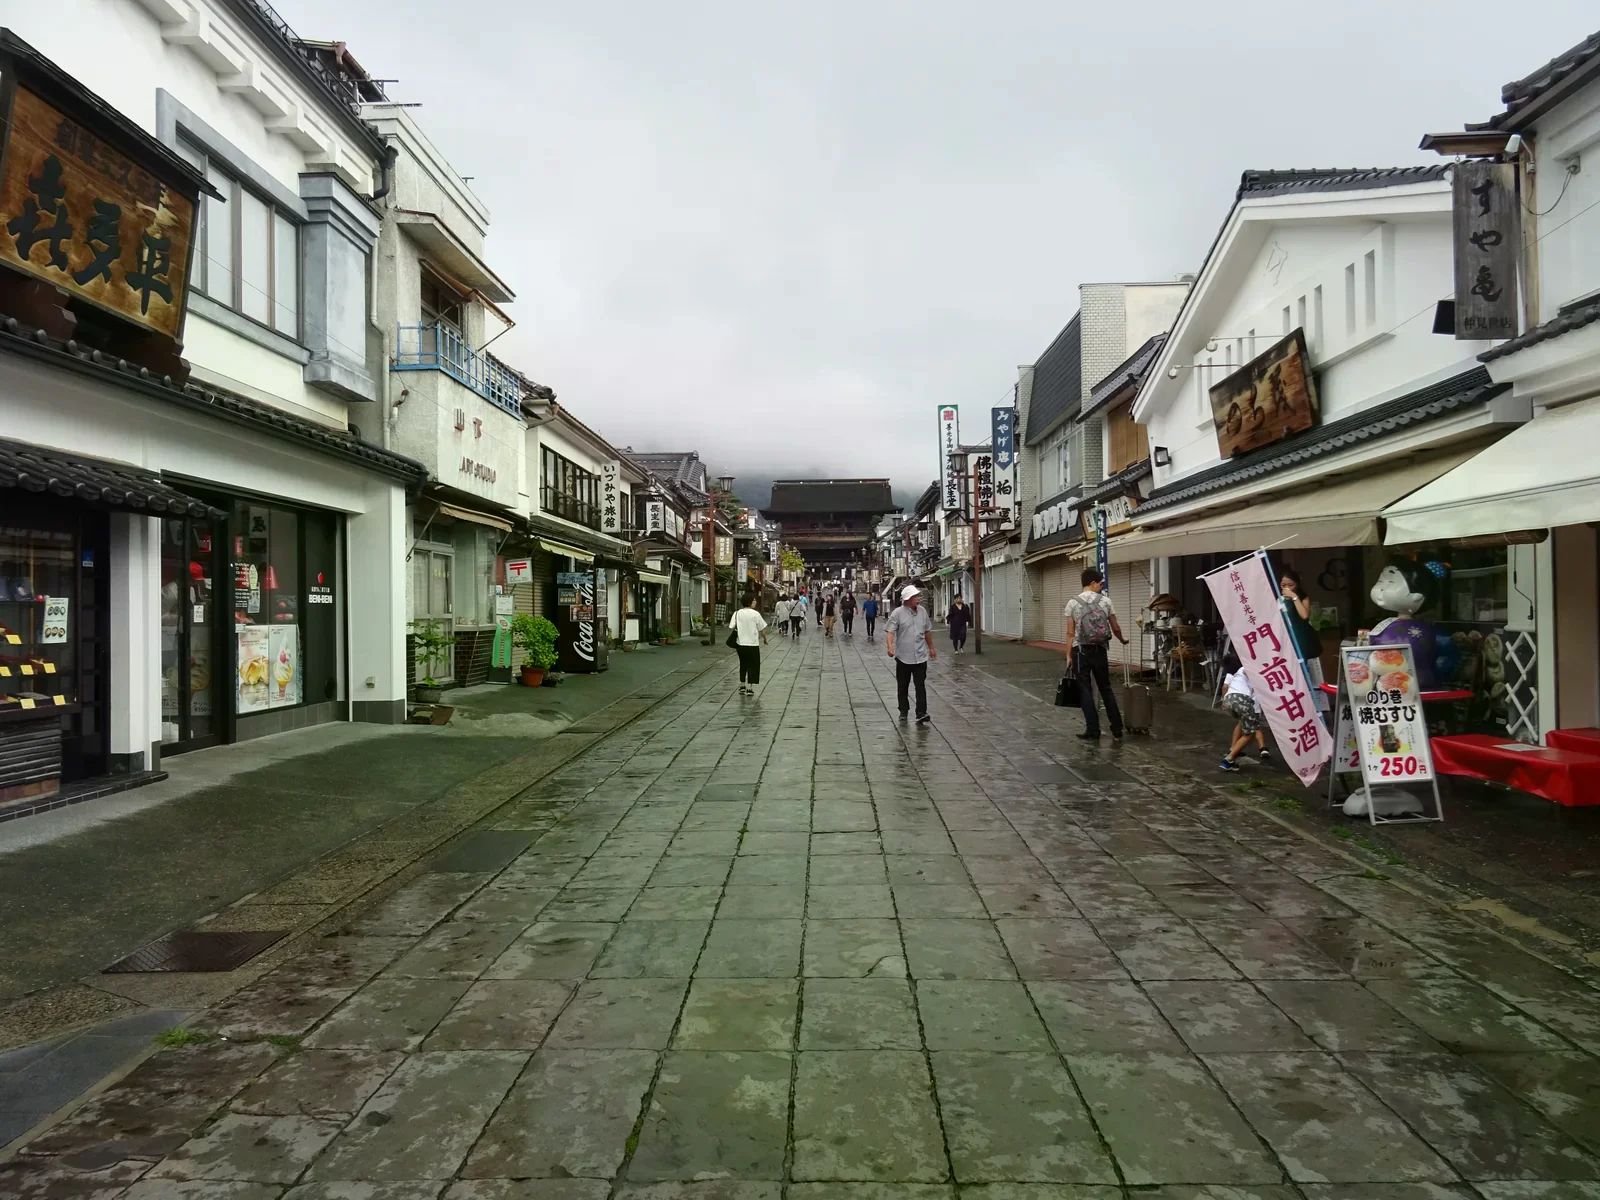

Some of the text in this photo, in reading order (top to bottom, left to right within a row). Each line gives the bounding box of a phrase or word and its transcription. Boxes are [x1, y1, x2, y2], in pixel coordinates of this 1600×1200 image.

[1469, 178, 1503, 303] すや亀
[996, 410, 1010, 463] みやげ店
[459, 456, 474, 475] ART
[603, 465, 617, 529] いづみや旅館
[649, 504, 660, 530] 長生堂
[1229, 571, 1257, 626] 信州善光寺
[1242, 622, 1320, 757] 門前甘酒
[1366, 690, 1402, 704] のり巻
[1358, 704, 1416, 725] 焼むすび
[1380, 756, 1418, 776] 250
